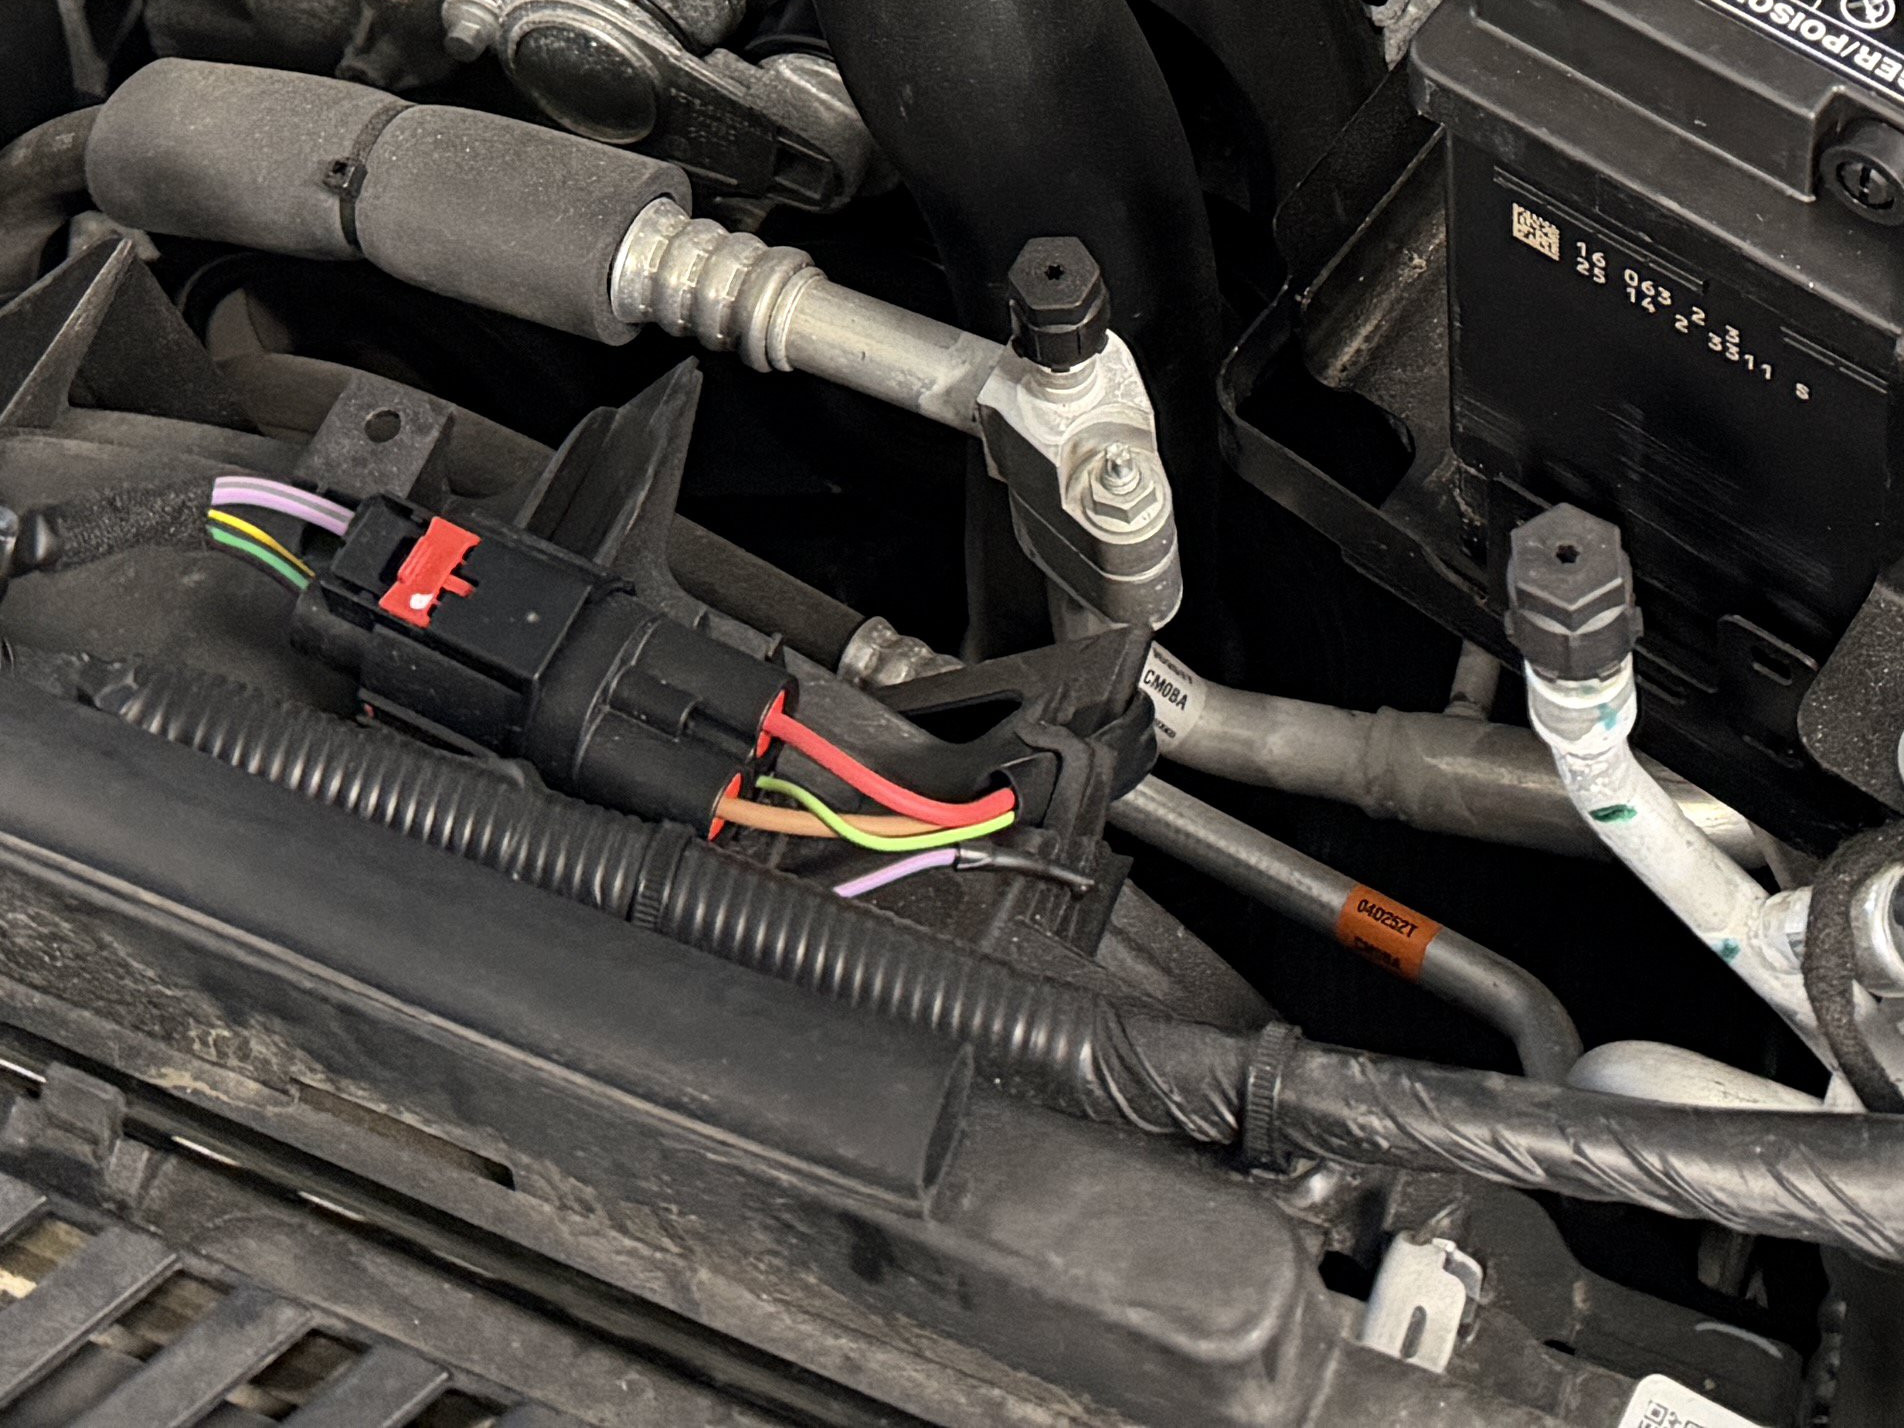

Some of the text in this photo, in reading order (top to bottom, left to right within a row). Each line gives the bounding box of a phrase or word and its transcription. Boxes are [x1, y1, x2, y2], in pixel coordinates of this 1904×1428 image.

[1572, 256, 1609, 285] 25
[1622, 285, 1659, 315] 14
[1670, 313, 1692, 334] 2
[1620, 267, 1675, 307] 063
[1687, 305, 1709, 326] 2
[1720, 325, 1743, 345] 3
